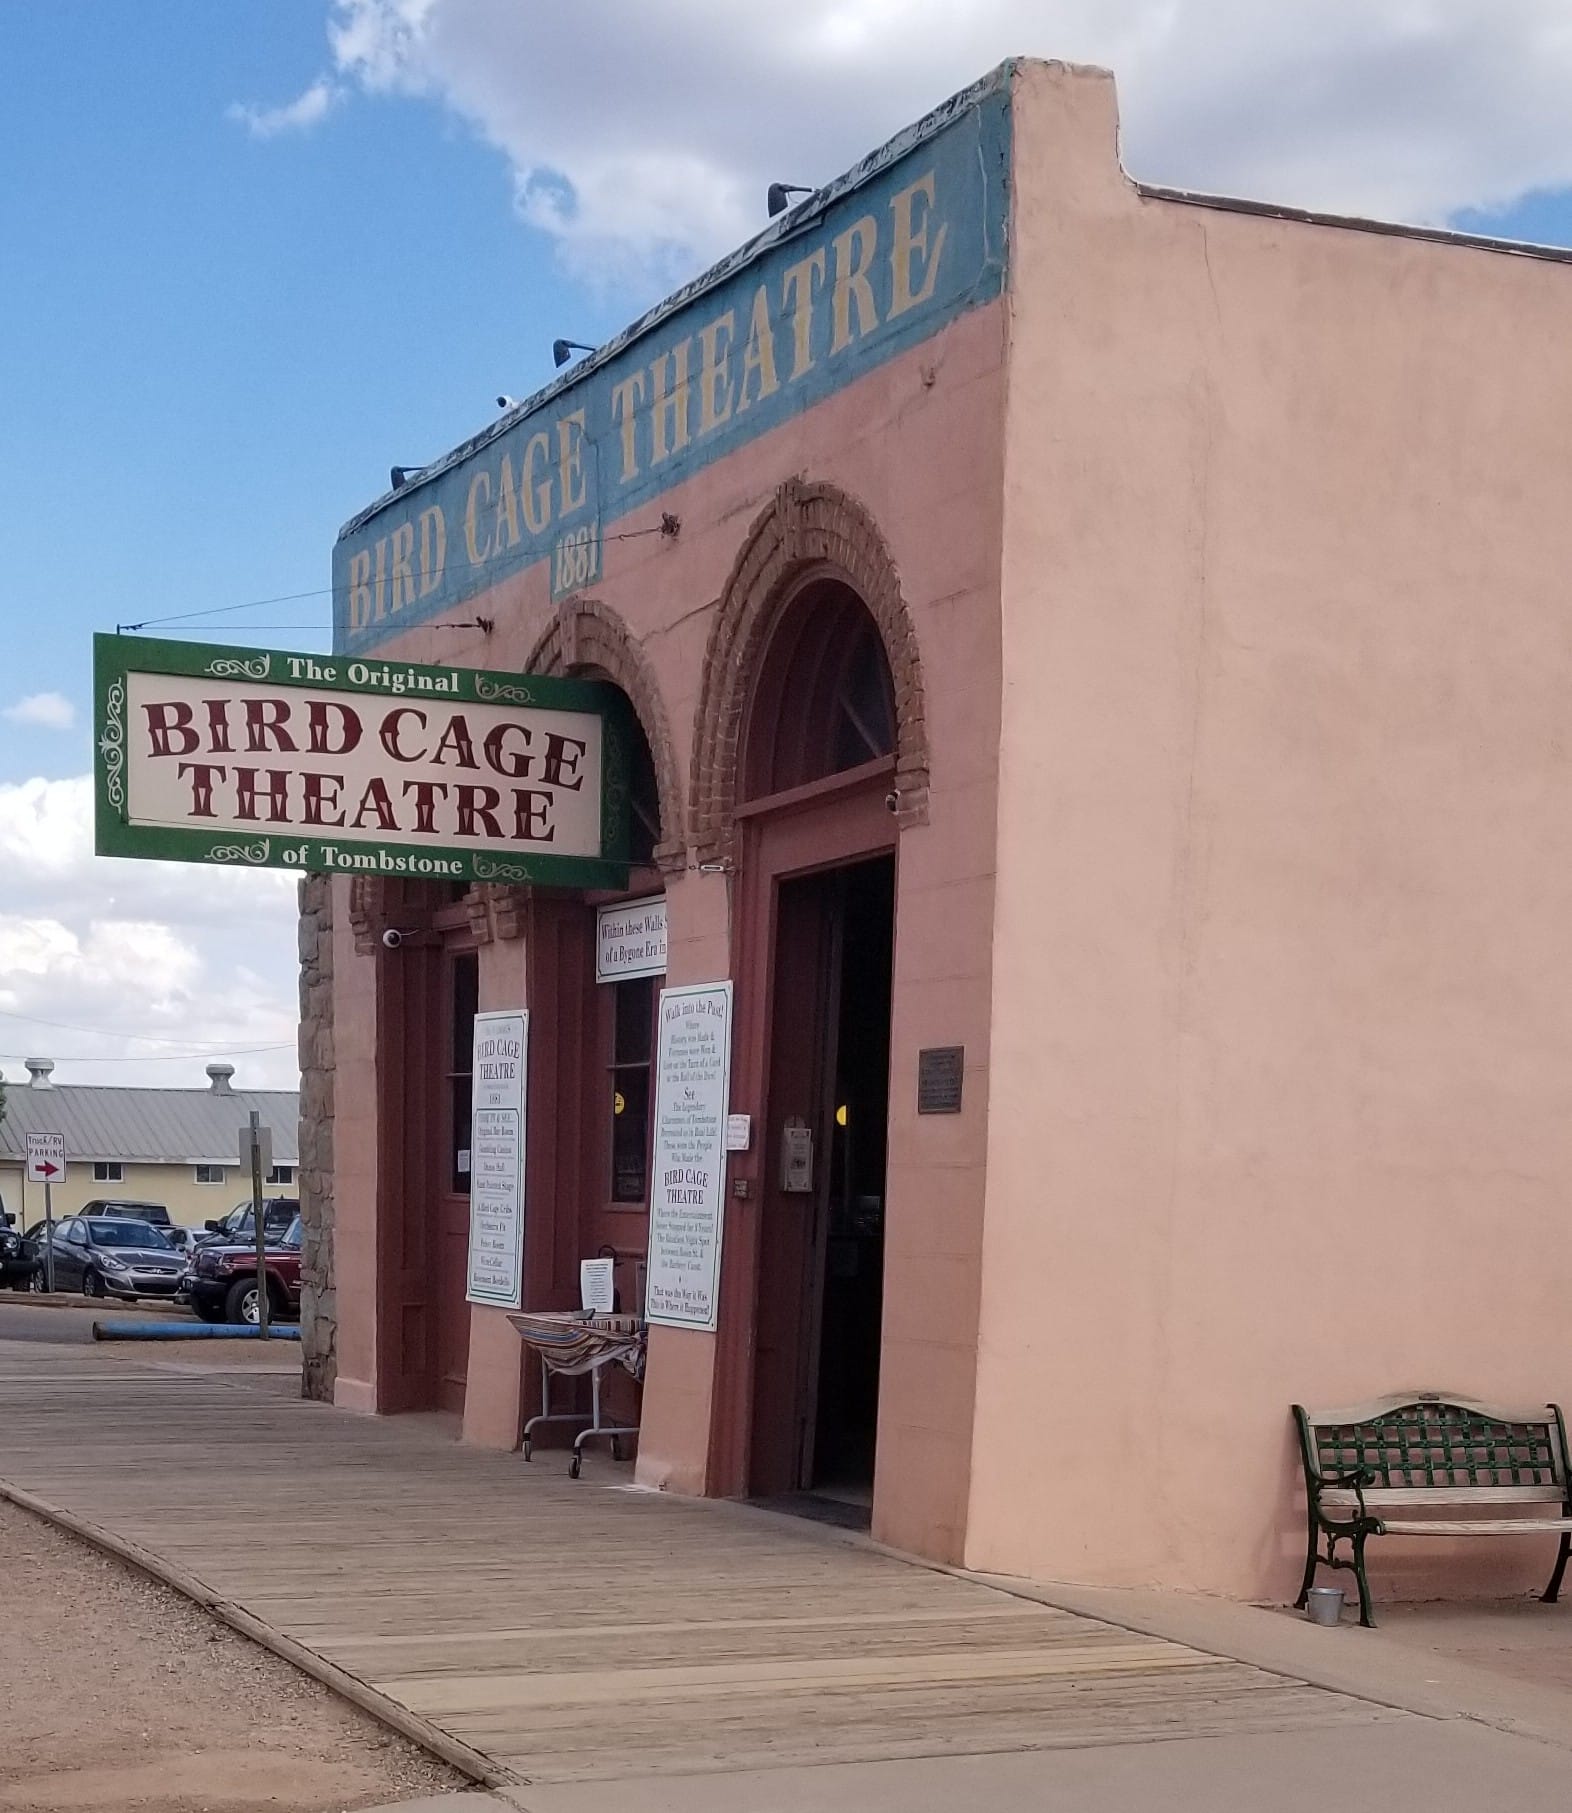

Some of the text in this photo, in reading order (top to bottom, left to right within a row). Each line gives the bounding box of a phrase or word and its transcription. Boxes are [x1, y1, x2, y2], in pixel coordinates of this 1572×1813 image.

[348, 170, 948, 635] BIRD CAGE THEATRE
[554, 521, 601, 593] 1881
[287, 657, 459, 693] The Original
[141, 699, 588, 791] BIRD CAGE
[177, 762, 556, 842] THEATRE
[282, 844, 463, 875] of Tombstone
[601, 922, 624, 940] Within
[625, 920, 643, 936] these
[645, 914, 663, 932] Walls
[605, 947, 613, 963] of
[614, 951, 618, 961] a
[620, 945, 644, 964] Bygone
[646, 941, 657, 957] Era
[666, 1000, 724, 1023] Walk into the Past!
[496, 1038, 520, 1059] CAGE
[480, 1062, 516, 1080] THEATRE
[684, 1086, 695, 1100] See
[28, 1148, 64, 1158] PARKING
[664, 1168, 709, 1188] BIRD CAGE
[666, 1188, 704, 1205] THEATRE
